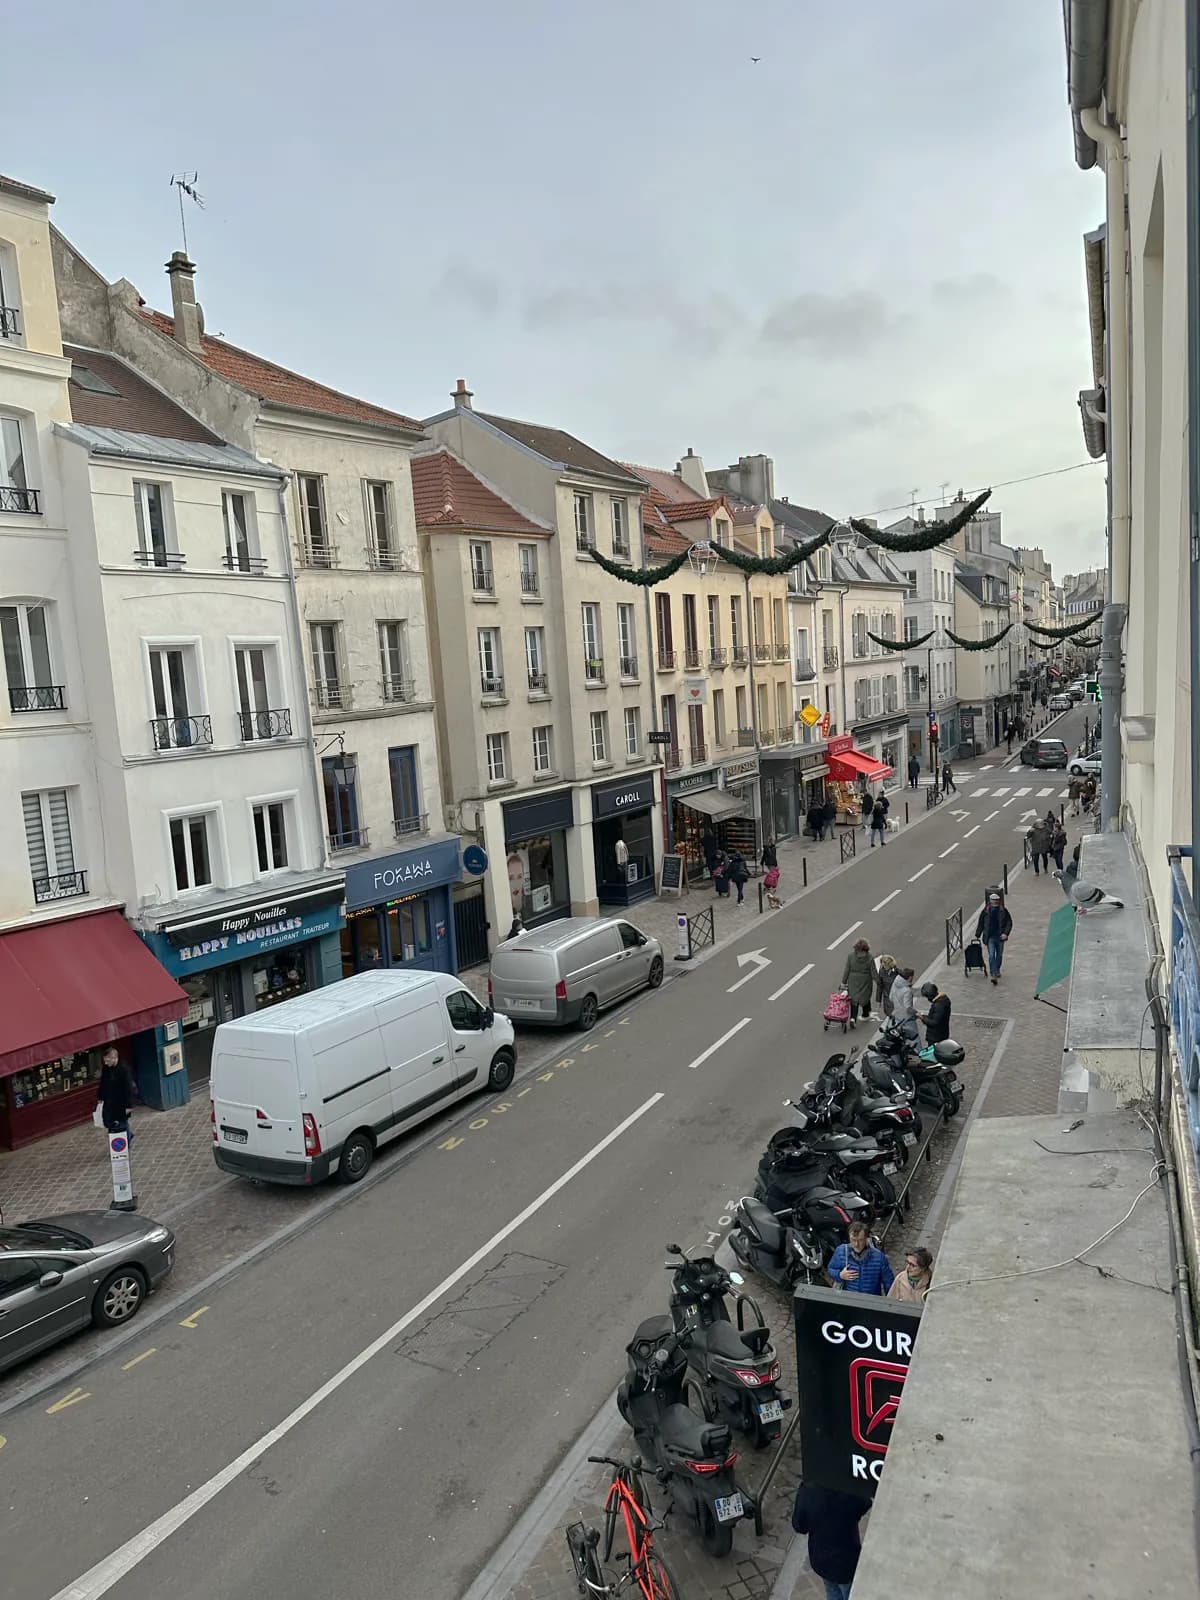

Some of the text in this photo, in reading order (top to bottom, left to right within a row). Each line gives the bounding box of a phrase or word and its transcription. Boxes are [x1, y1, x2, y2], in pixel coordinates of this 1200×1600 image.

[615, 792, 640, 806] CAROLL
[374, 860, 433, 889] POKAWA
[222, 906, 288, 931] Happy Nouilles
[179, 916, 303, 961] HAPPY NOUILLES
[260, 921, 330, 949] RESTAURANT TRAITEUR
[821, 1320, 912, 1357] GOUR
